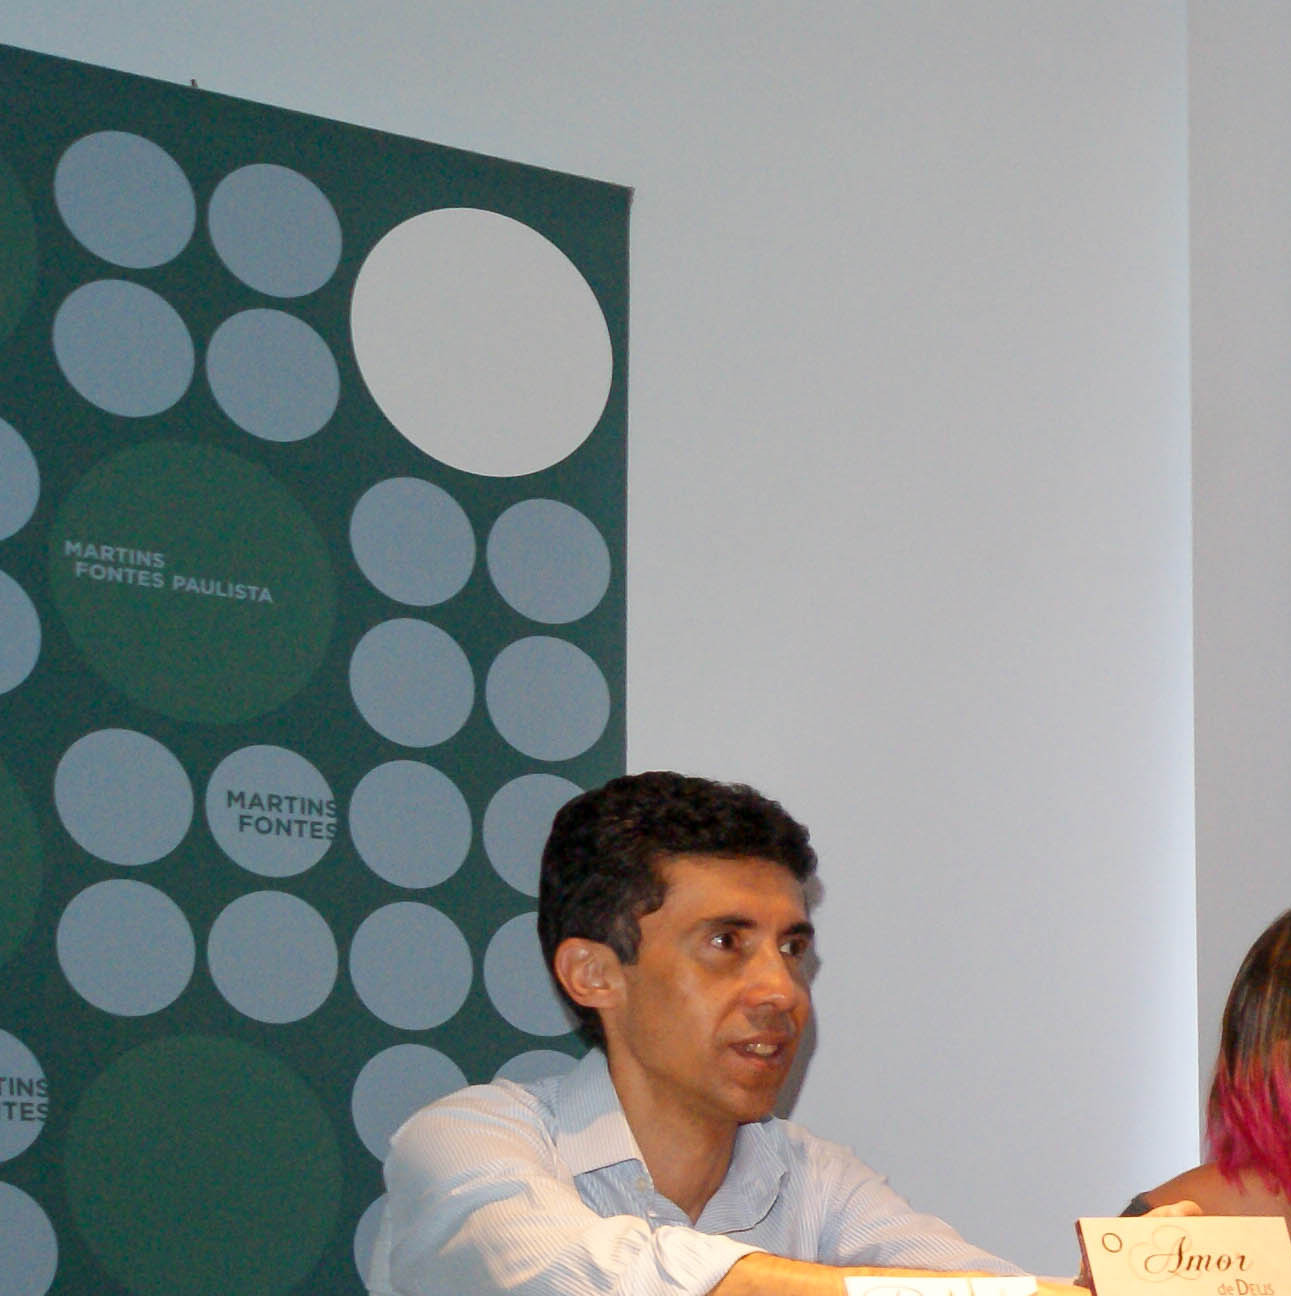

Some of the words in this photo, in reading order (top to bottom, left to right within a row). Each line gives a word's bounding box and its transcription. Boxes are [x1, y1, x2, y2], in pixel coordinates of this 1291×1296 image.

[63, 540, 165, 569] MARTINS
[74, 560, 165, 588] FONTES
[172, 575, 273, 603] PAULISTA
[227, 790, 338, 819] MARTINS
[238, 814, 338, 841] FONTES
[1102, 1233, 1122, 1253] O
[1137, 1230, 1248, 1278] Amor
[1218, 1283, 1234, 1295] de
